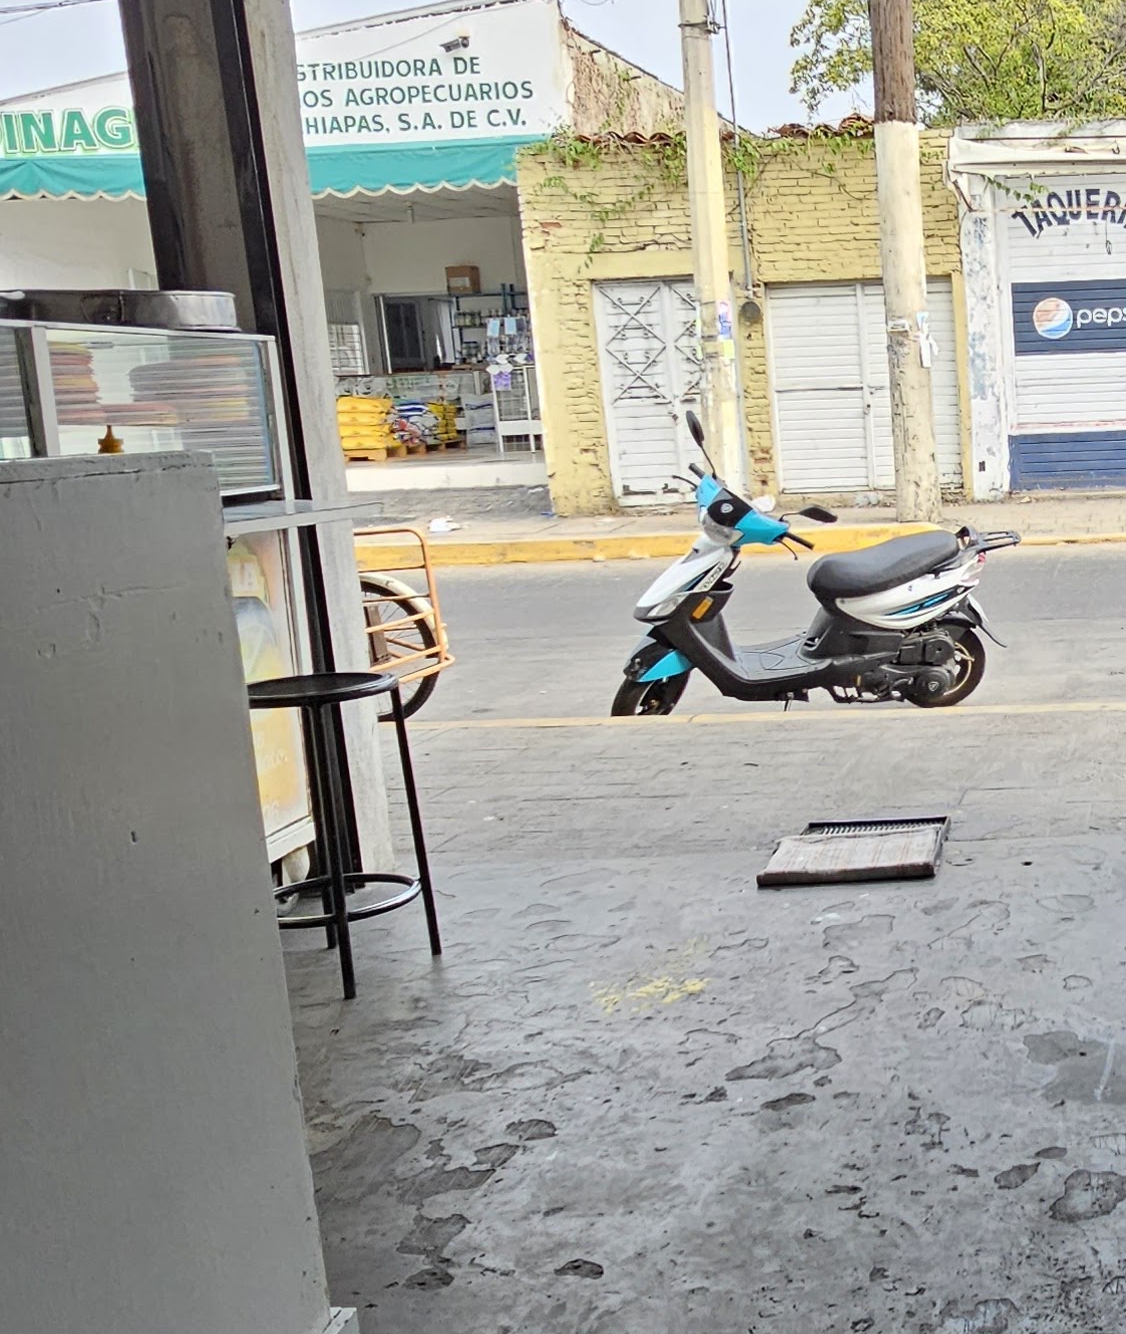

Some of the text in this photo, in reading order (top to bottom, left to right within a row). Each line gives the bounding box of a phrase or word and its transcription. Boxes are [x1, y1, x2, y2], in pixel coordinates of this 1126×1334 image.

[453, 56, 481, 75] DE
[345, 80, 533, 107] AGROPECUARIOS
[397, 112, 443, 132] S.A.
[450, 110, 478, 129] DE
[486, 108, 527, 128] C.V.
